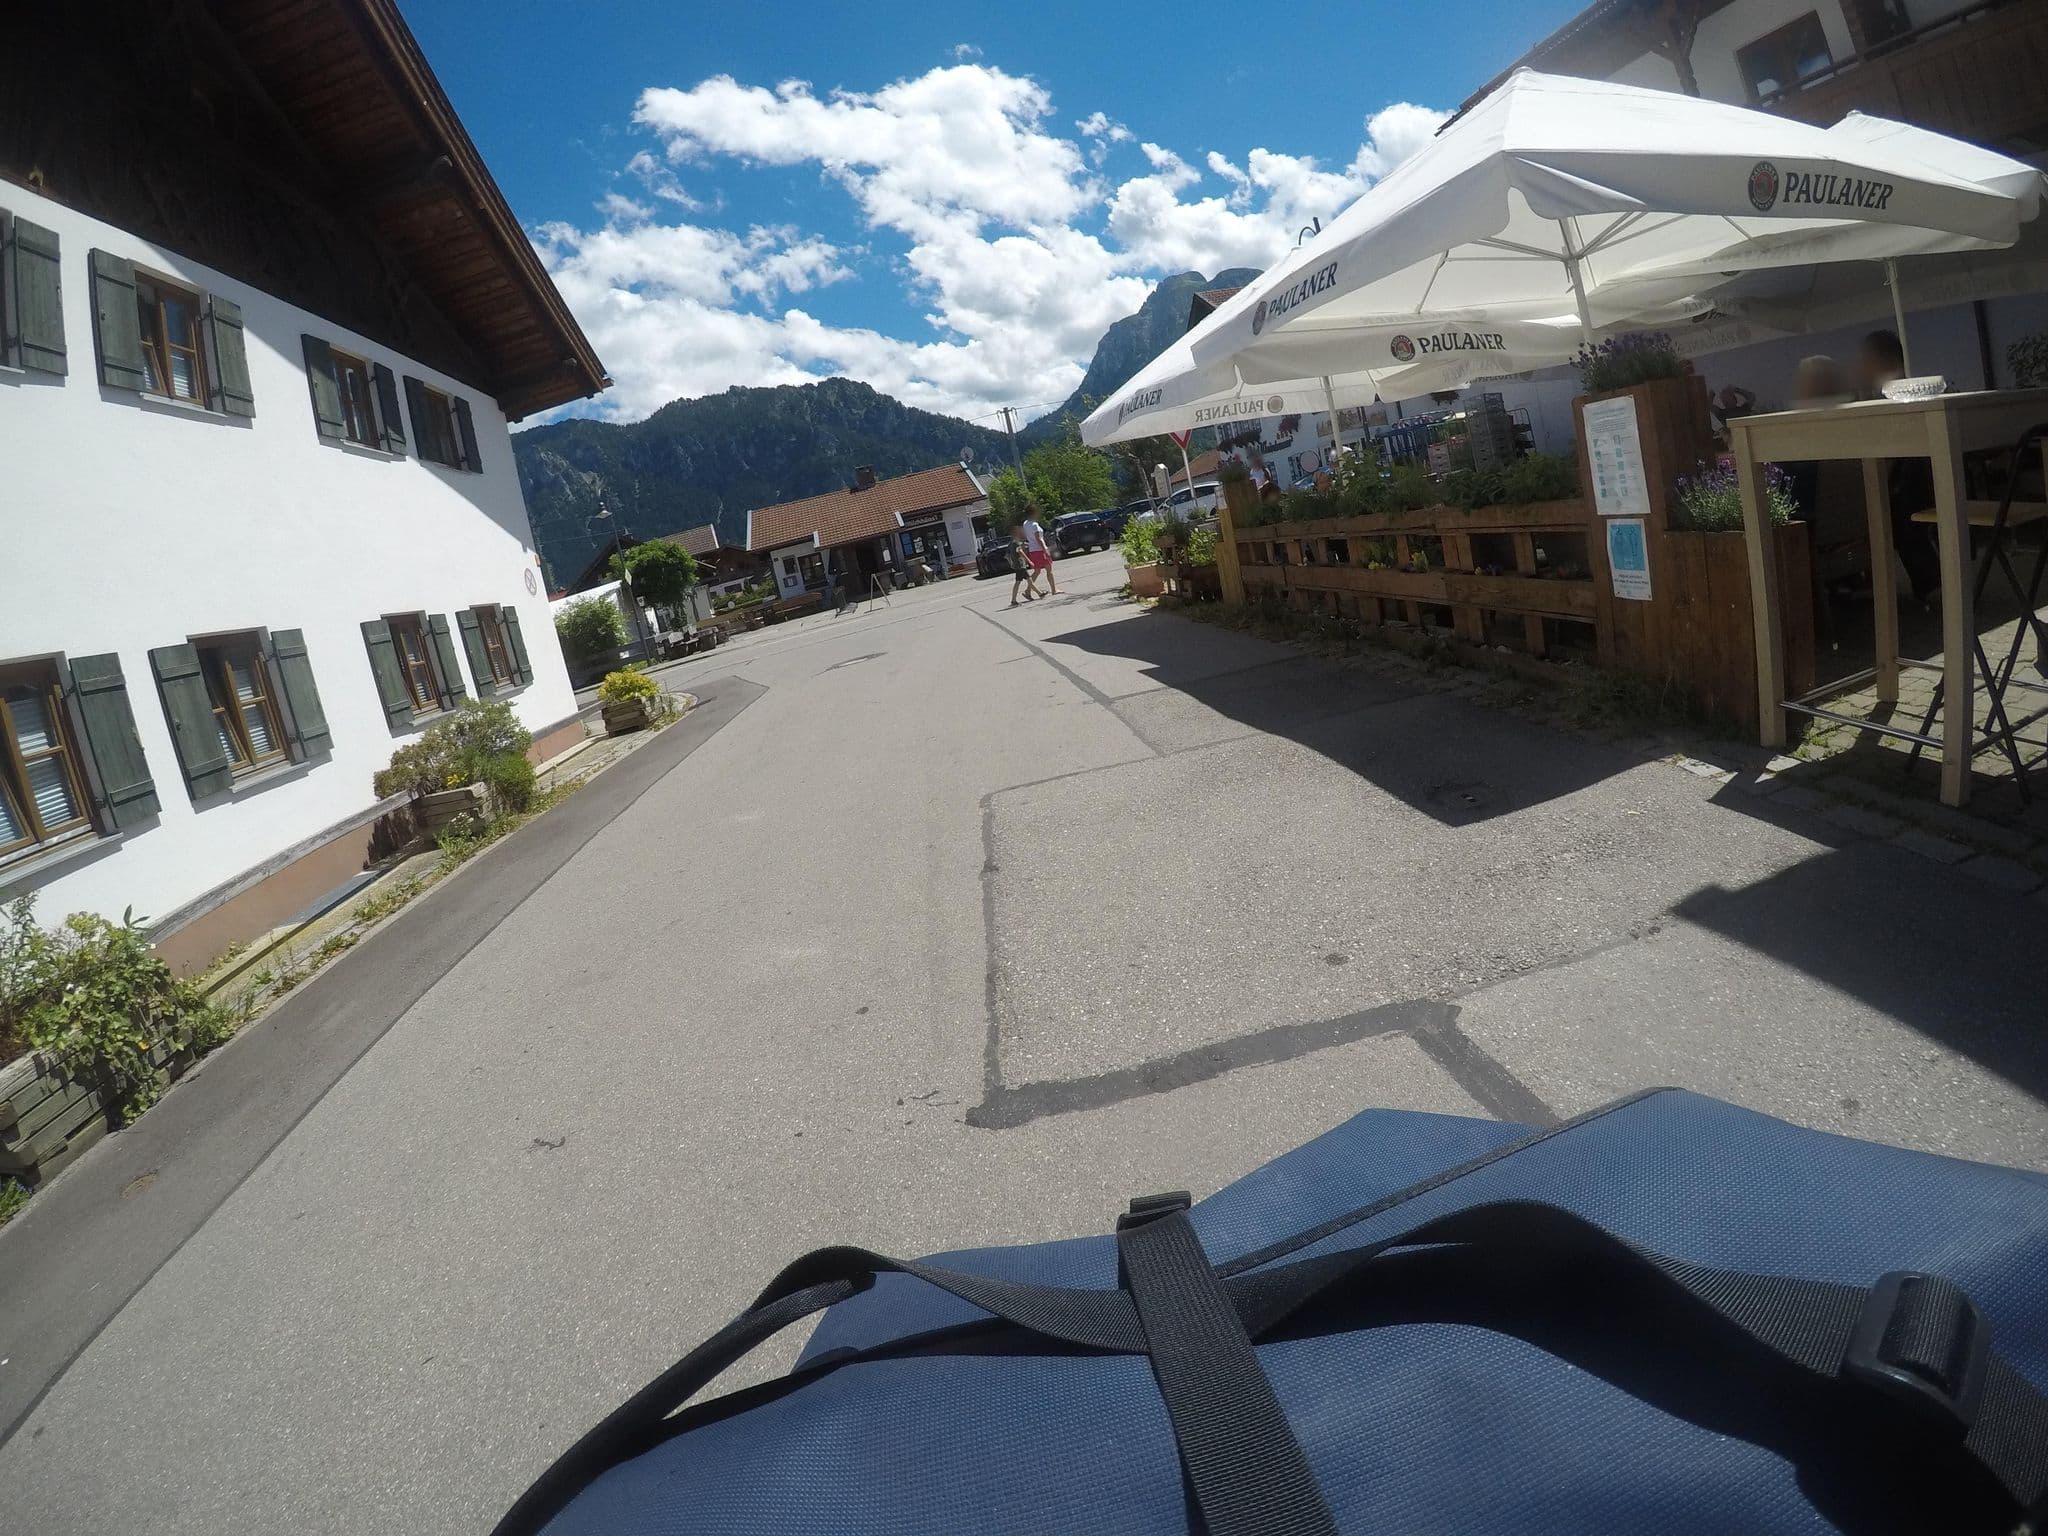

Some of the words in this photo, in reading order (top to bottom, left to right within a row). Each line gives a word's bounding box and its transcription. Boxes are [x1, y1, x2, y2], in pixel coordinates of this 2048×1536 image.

[1783, 173, 1893, 209] PAULANER
[1269, 262, 1338, 316] PAULANER
[1417, 333, 1506, 354] PAULANER
